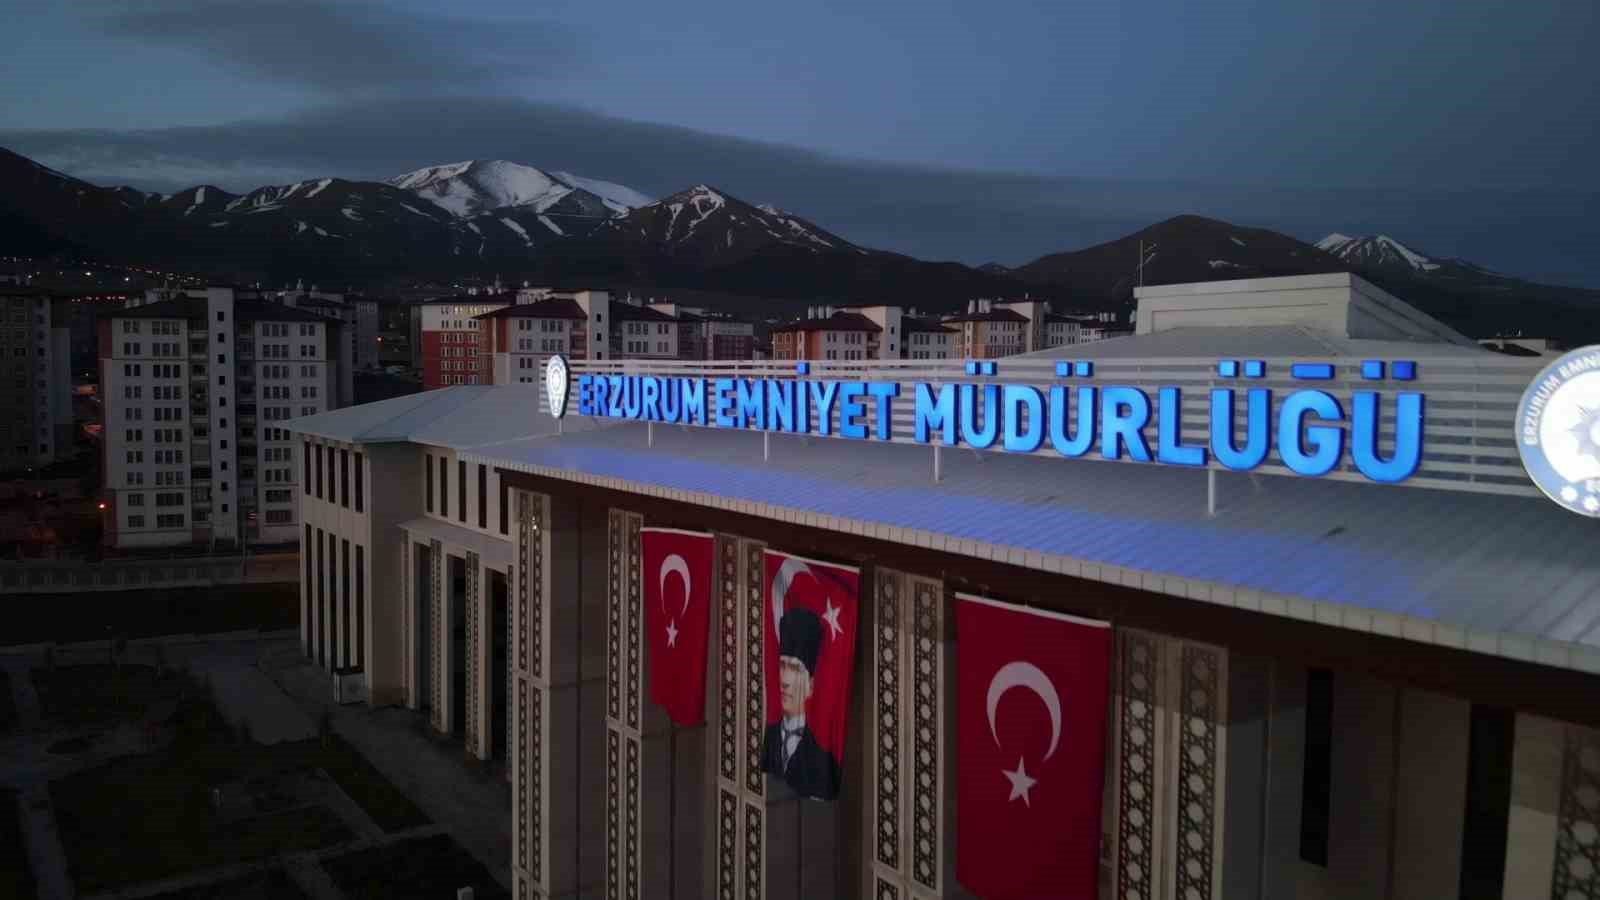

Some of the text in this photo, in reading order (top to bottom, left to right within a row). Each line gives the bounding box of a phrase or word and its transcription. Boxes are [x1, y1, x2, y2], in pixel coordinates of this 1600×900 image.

[578, 374, 708, 425] ERZURUM
[715, 362, 900, 440] EMNİYET
[913, 360, 1425, 483] MÜDÜRLÜĞÜ
[1524, 374, 1560, 445] ERZURUM
